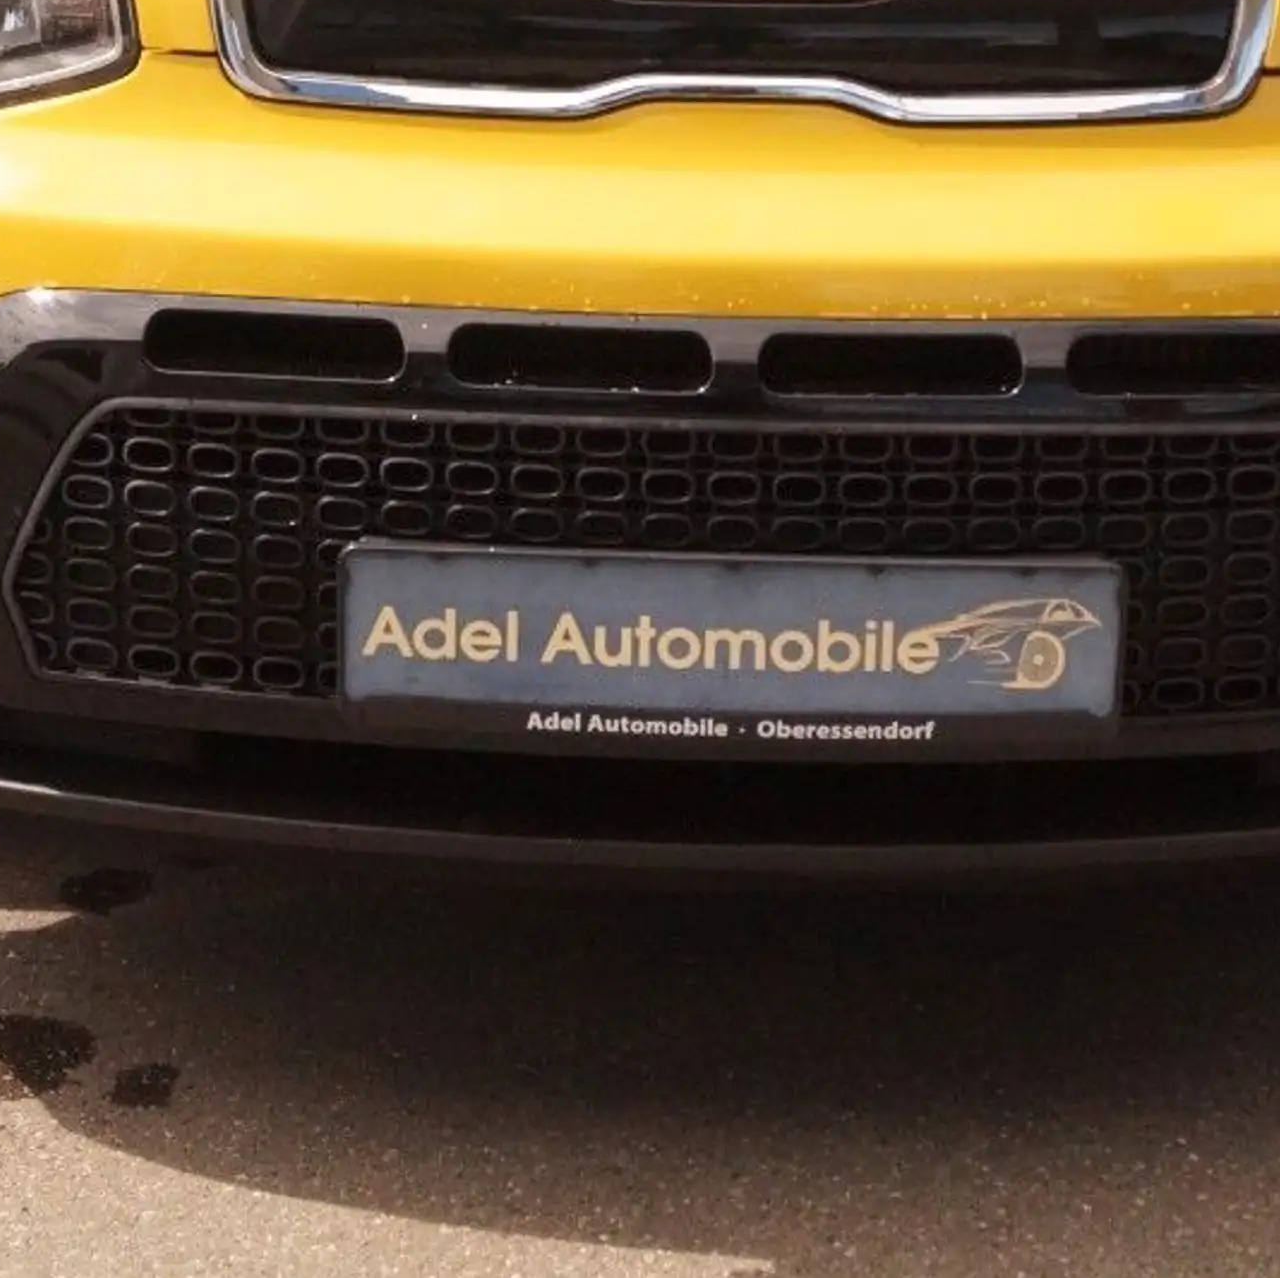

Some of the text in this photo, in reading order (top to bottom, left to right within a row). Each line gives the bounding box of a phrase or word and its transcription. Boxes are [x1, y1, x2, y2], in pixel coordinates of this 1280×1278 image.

[362, 605, 941, 674] Adel Automobile
[527, 712, 581, 732] Adel
[587, 713, 728, 738] Automobile
[756, 720, 936, 741] Oberessendorf
